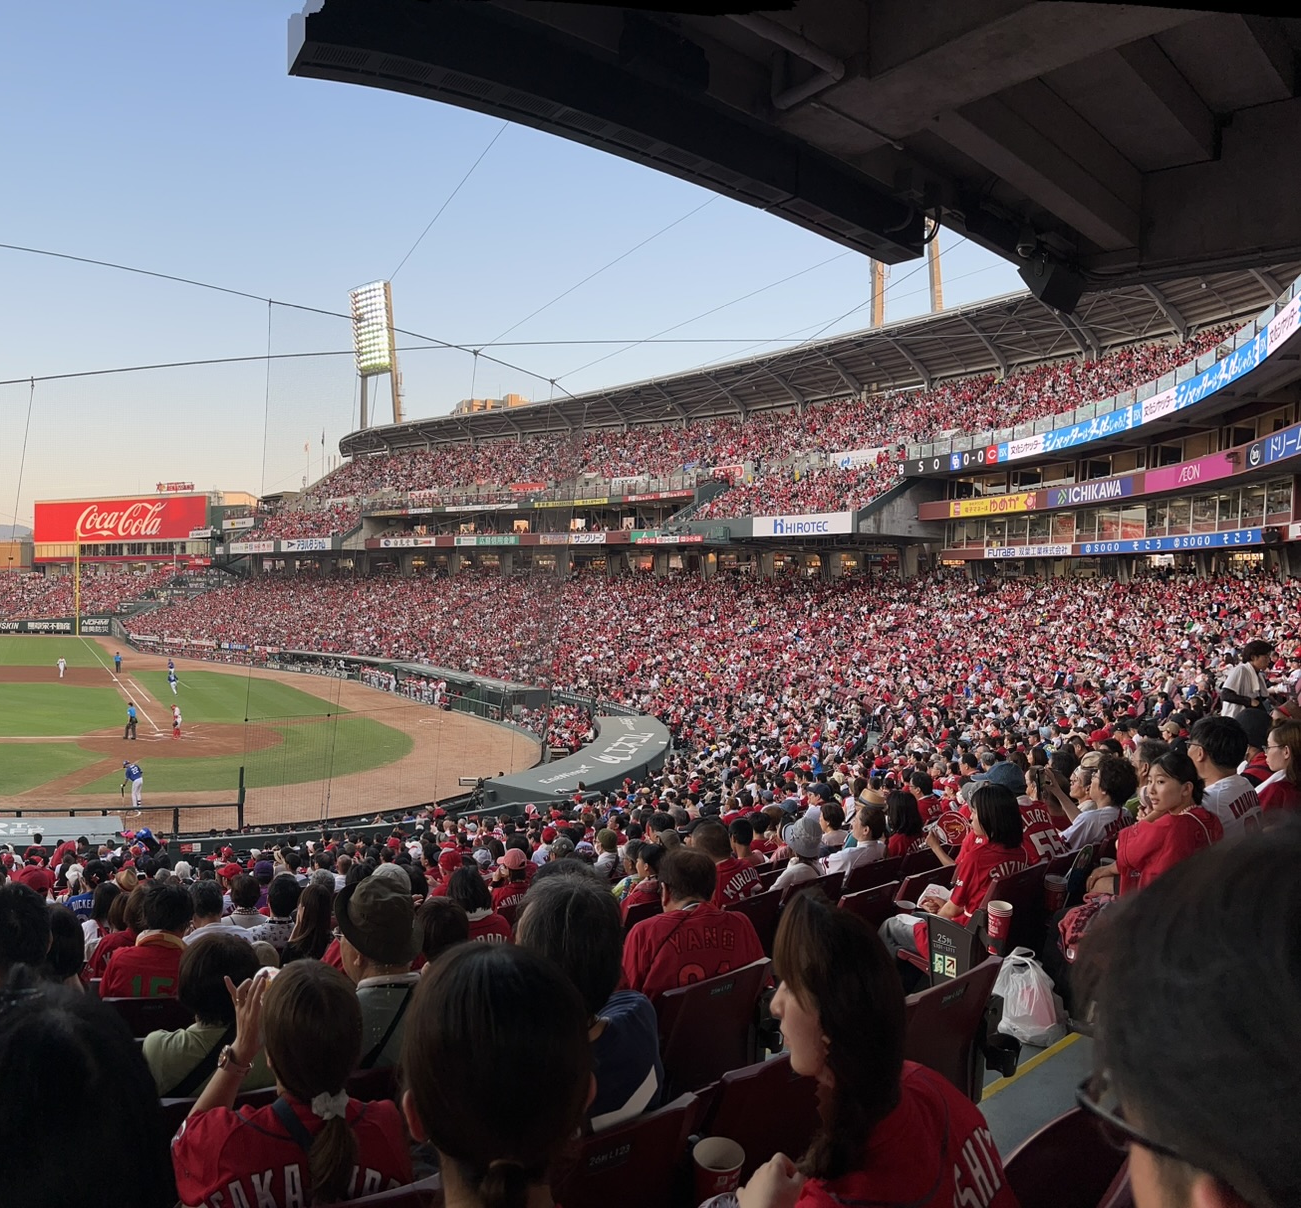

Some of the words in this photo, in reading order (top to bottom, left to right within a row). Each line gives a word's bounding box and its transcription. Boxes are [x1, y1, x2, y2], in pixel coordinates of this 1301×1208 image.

[1068, 479, 1122, 504] ICHIKAWA
[75, 501, 167, 537] Coca-Cola
[785, 521, 829, 534] HIROTEC
[574, 533, 605, 543] サニクリーン
[1183, 535, 1211, 547] SOGO
[1223, 530, 1253, 545] そごう
[1094, 543, 1120, 552] SOGO
[1132, 540, 1162, 551] そごう
